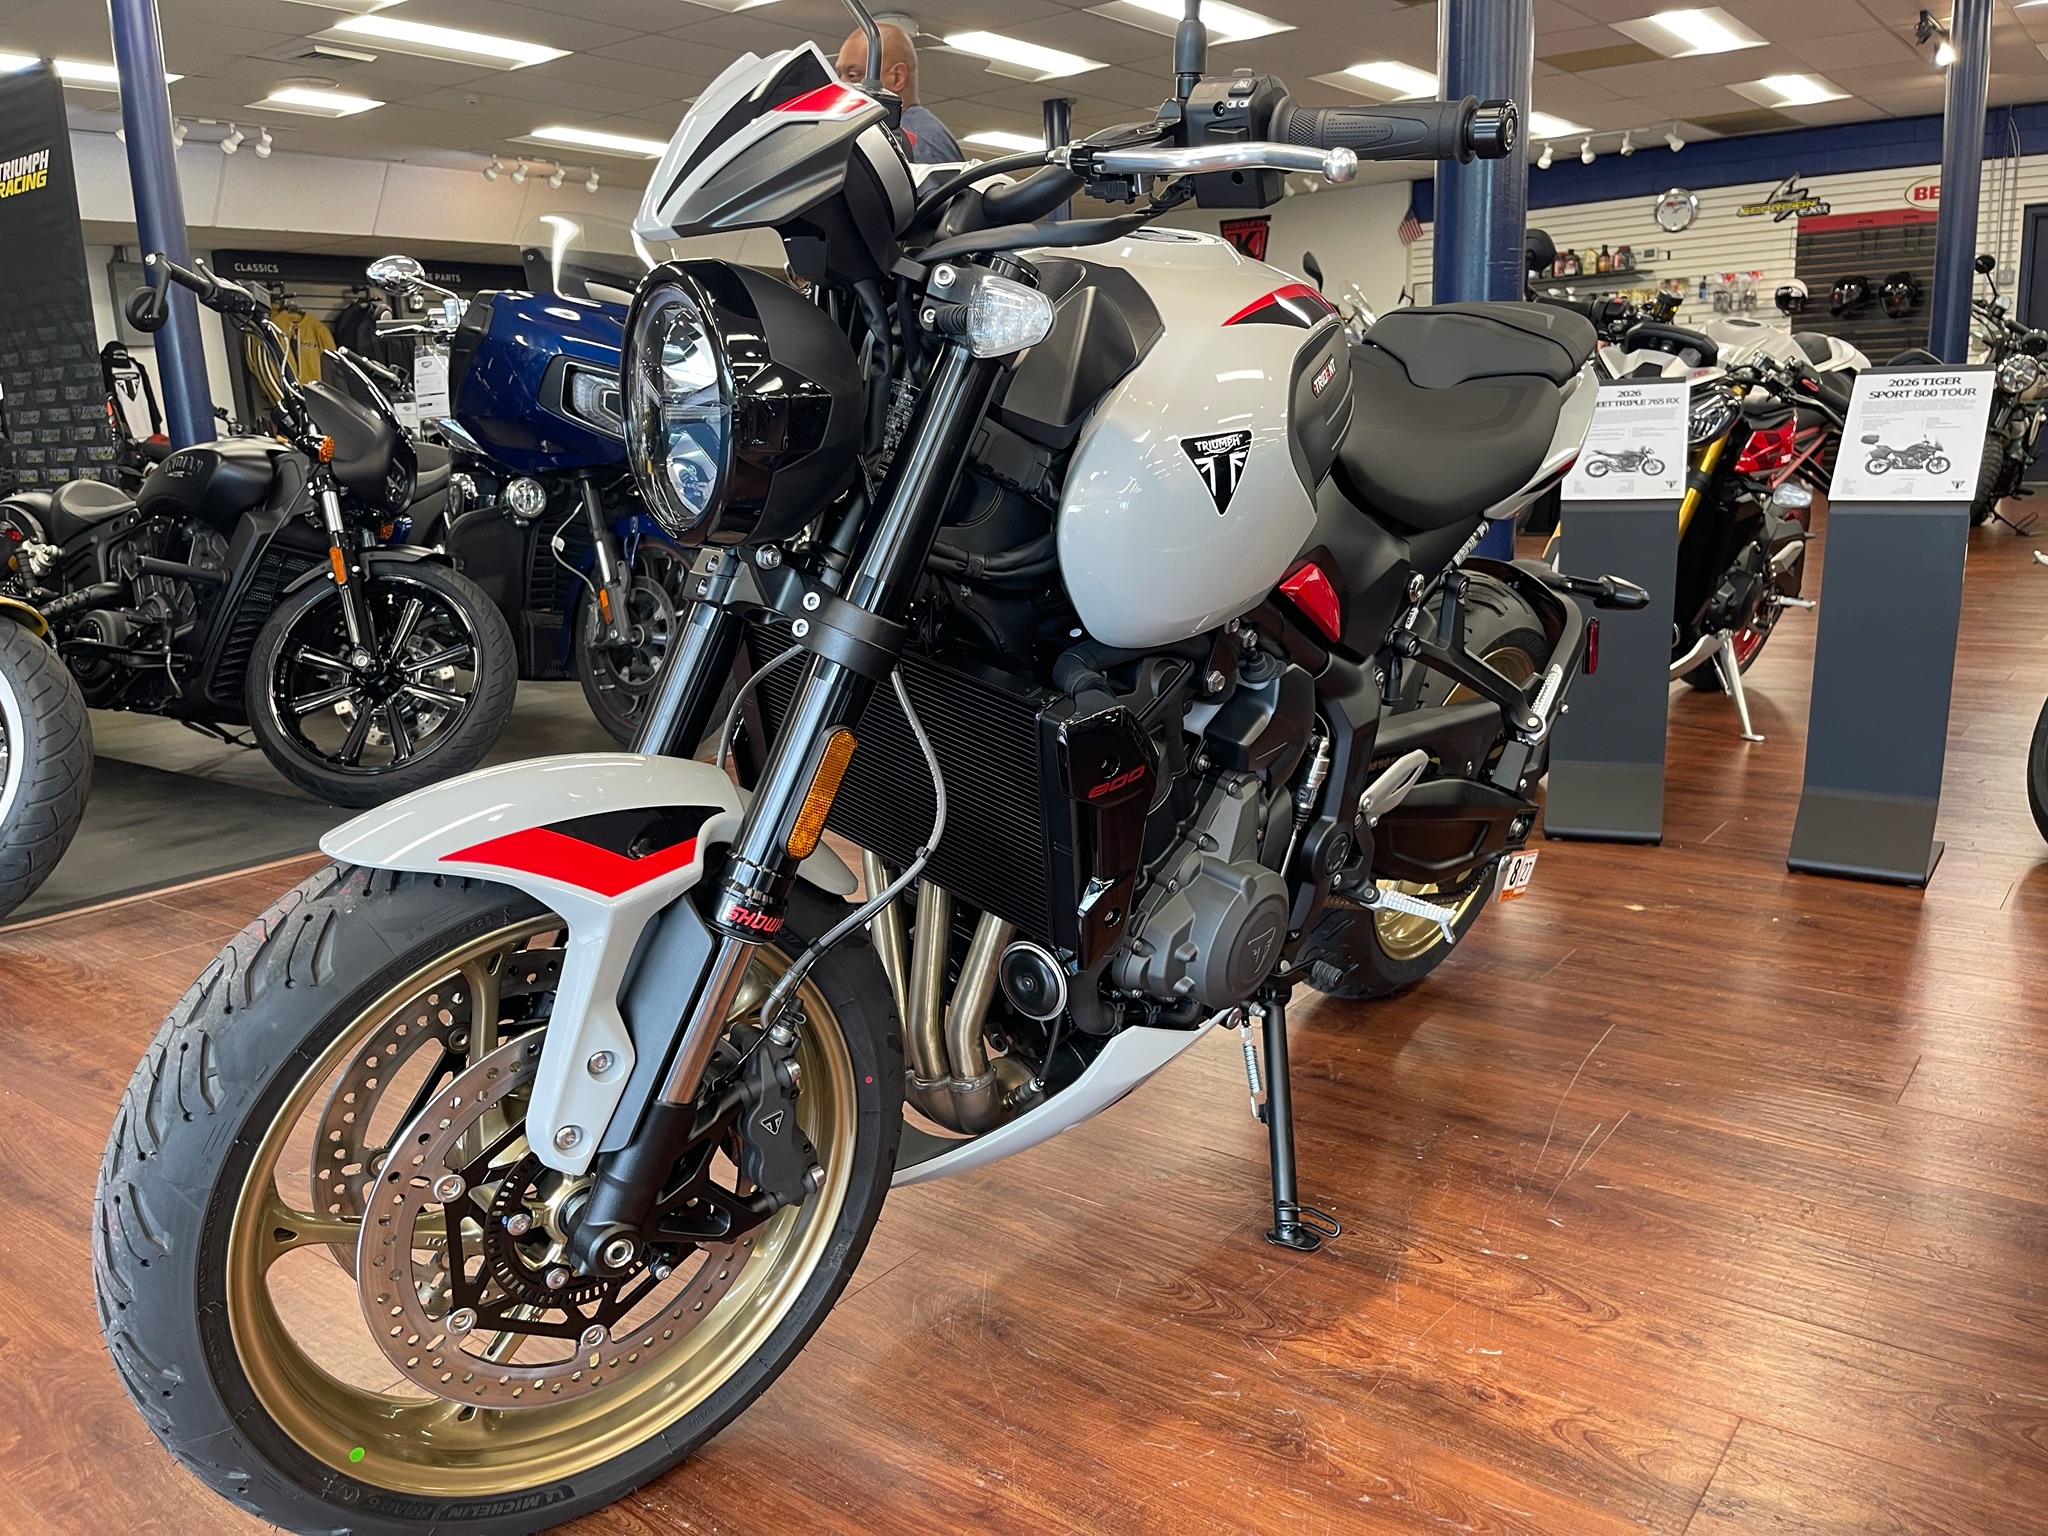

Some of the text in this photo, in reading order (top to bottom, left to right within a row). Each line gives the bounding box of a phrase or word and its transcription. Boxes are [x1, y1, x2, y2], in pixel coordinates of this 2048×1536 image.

[0, 149, 50, 182] TRIUMPH
[0, 169, 48, 199] RACING
[1914, 185, 1940, 201] BE
[234, 262, 280, 274] CLASSICS
[434, 273, 461, 283] PARTS
[1888, 376, 1962, 387] 2026 TIGER
[1617, 390, 1642, 398] 2026
[1868, 387, 1977, 399] SPORT 800 TOUR
[1613, 399, 1647, 407] TRIPLE
[1194, 433, 1242, 453] TRIUMPH
[1088, 764, 1146, 799] 800
[1509, 858, 1532, 886] 8 27
[449, 1495, 539, 1519] MICHELIN
